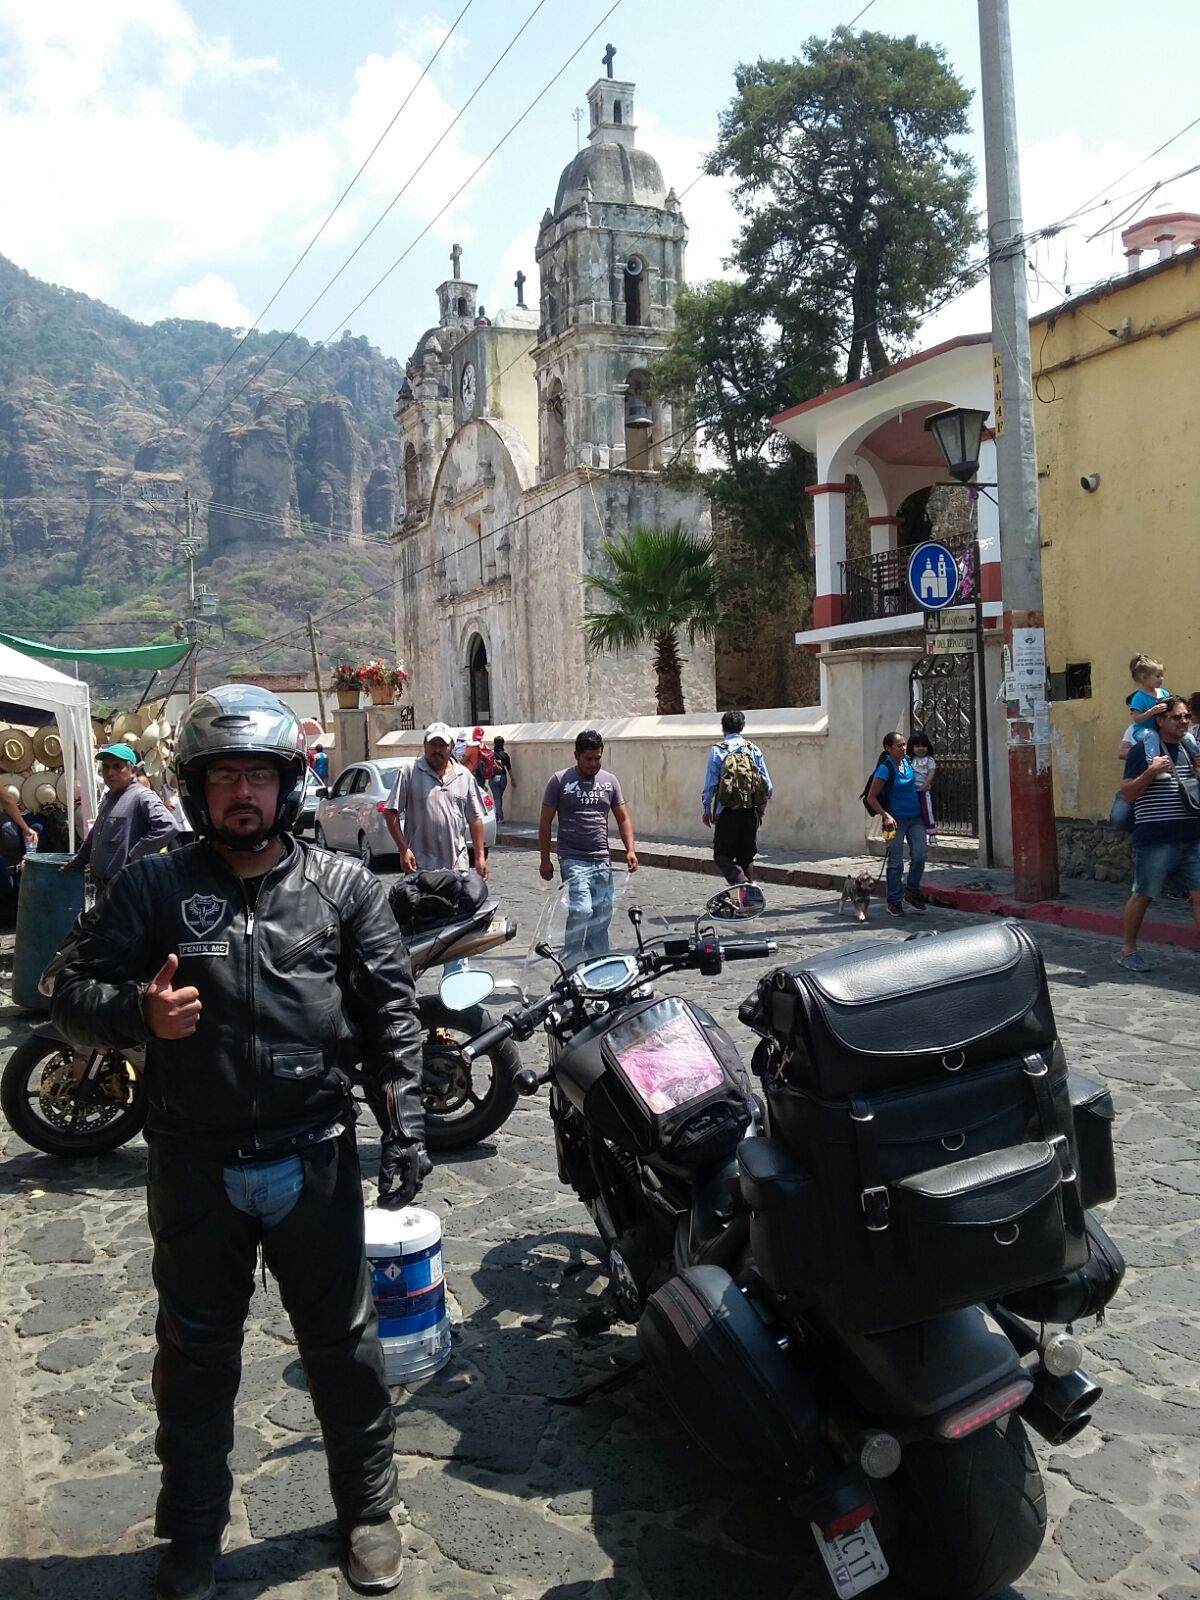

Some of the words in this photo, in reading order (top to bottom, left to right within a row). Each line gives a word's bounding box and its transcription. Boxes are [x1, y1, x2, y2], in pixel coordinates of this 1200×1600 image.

[576, 790, 605, 798] EAGLE
[580, 797, 599, 805] 1977
[182, 944, 208, 953] FENIX
